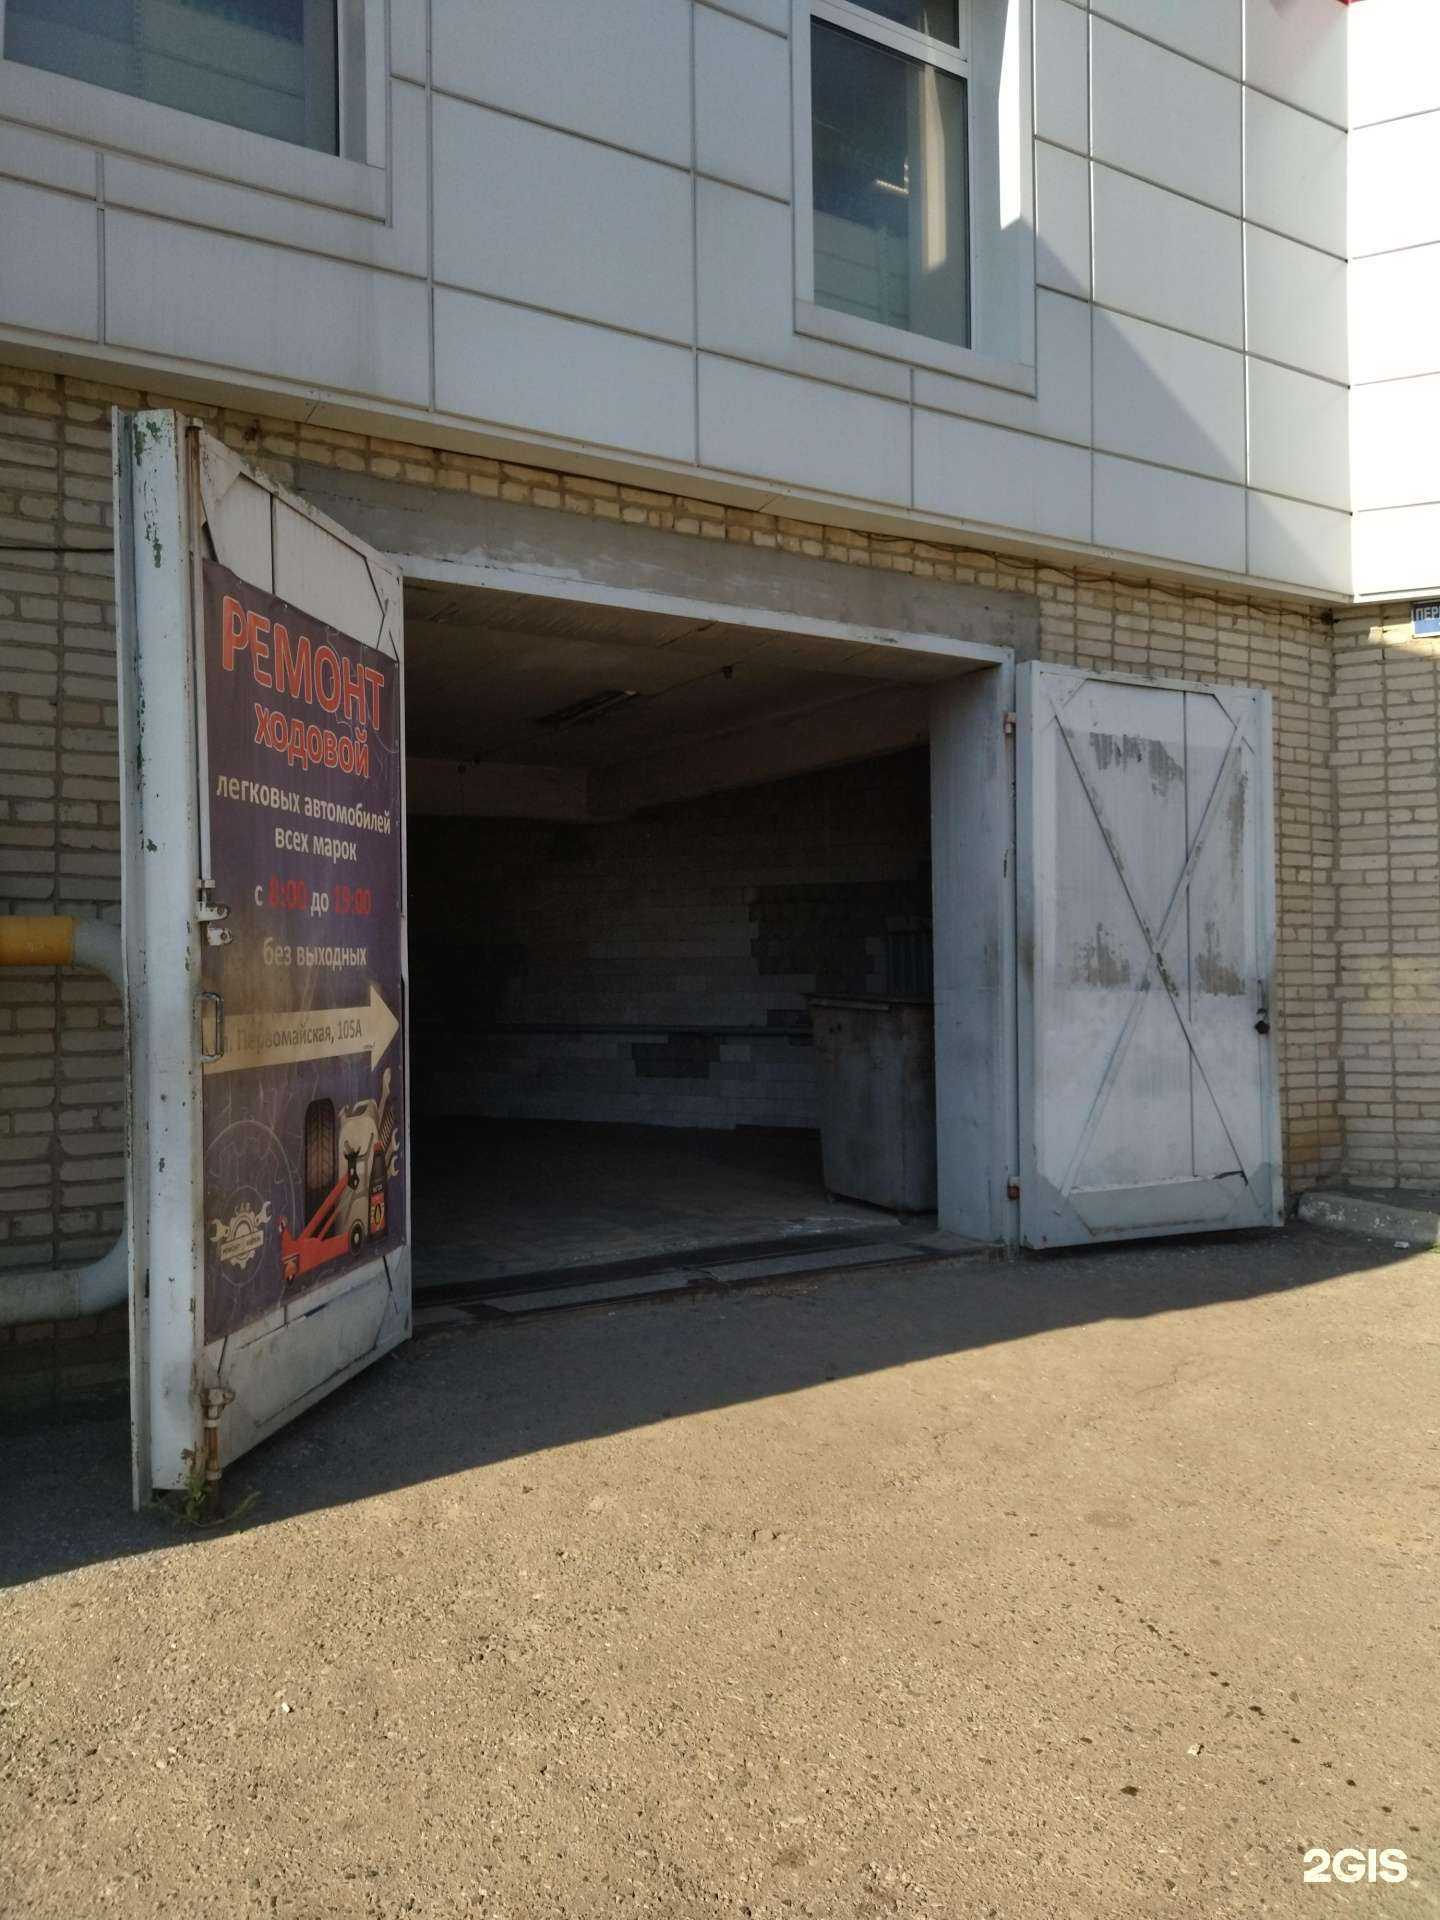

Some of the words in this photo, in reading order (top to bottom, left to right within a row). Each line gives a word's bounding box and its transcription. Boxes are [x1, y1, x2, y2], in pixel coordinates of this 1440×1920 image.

[221, 595, 385, 731] РЕМОНТ
[254, 703, 370, 778] ХОДОВОЙ
[216, 775, 300, 814] легковых
[304, 795, 391, 835] автомобилей
[275, 826, 309, 853] всех
[313, 837, 358, 864] марок
[310, 892, 329, 917] до
[263, 936, 292, 966] без
[296, 945, 367, 971] выходных
